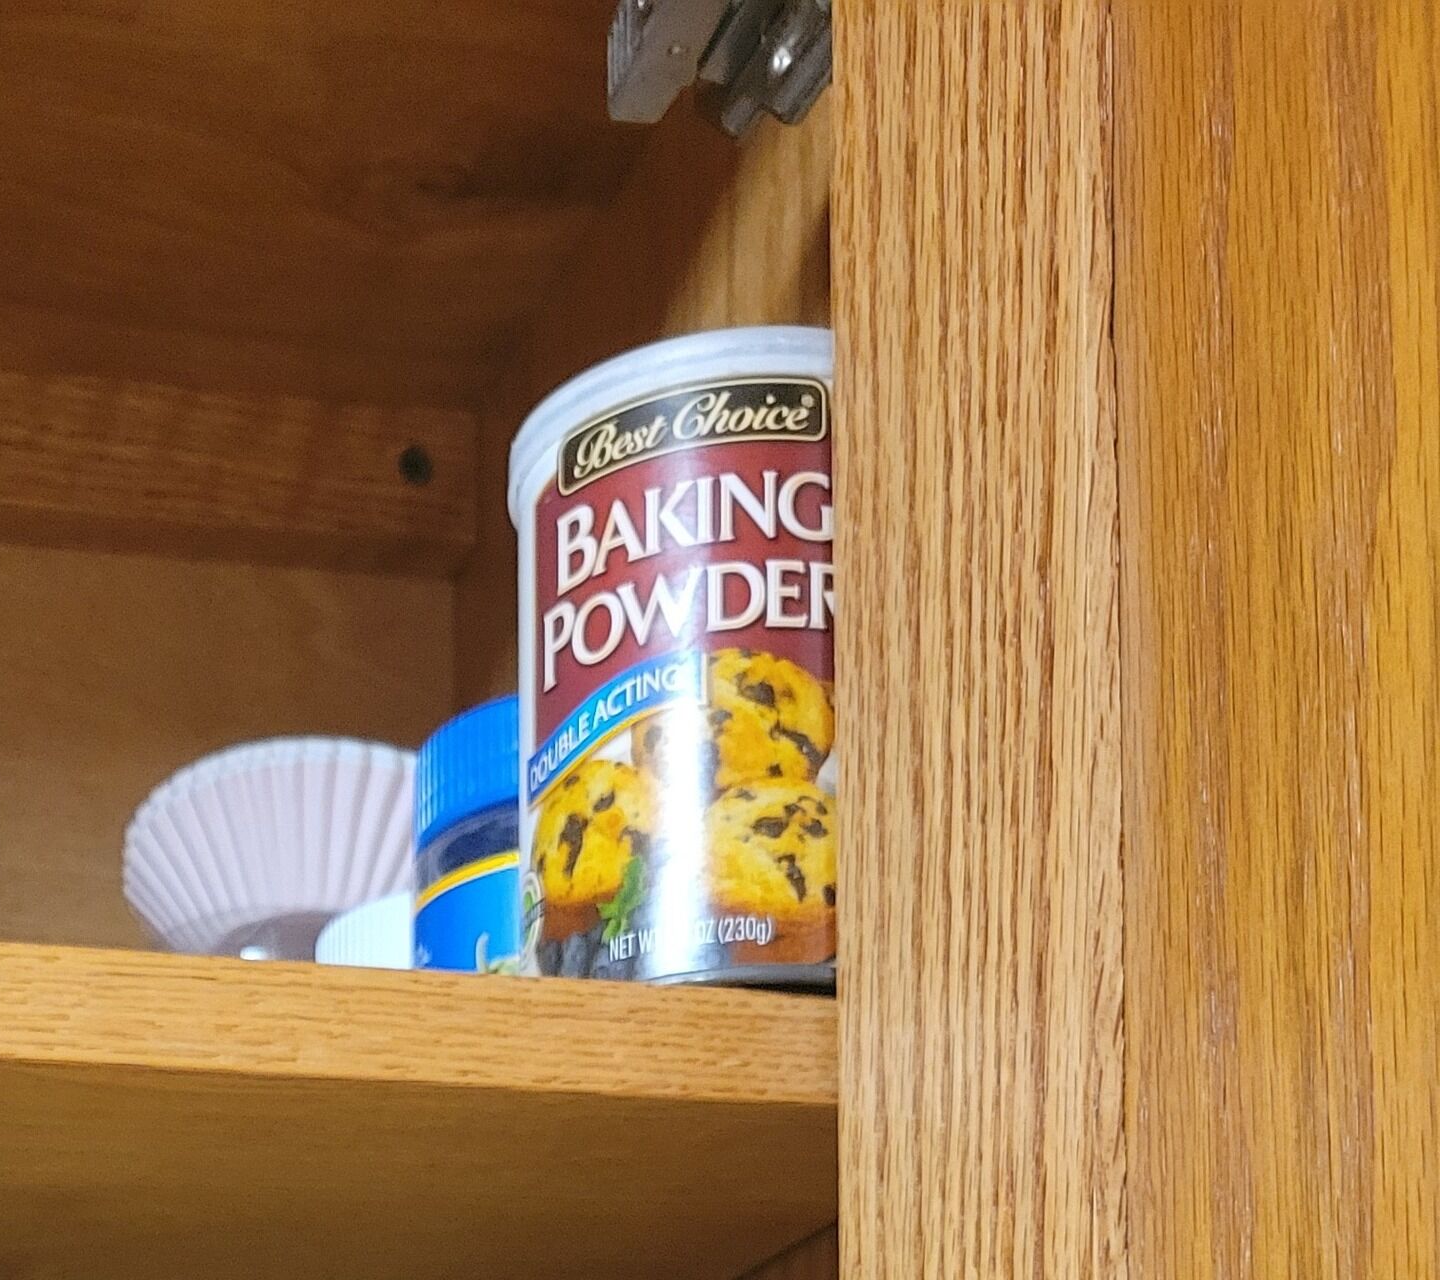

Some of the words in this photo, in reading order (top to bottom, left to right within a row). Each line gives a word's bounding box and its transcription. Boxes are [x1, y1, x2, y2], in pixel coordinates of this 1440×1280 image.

[573, 413, 667, 480] Best
[672, 392, 812, 441] Choice
[557, 470, 833, 597] BAKING
[543, 559, 834, 694] POWDER
[530, 711, 591, 793] DOUBLE
[593, 664, 682, 729] ACTING
[609, 932, 636, 962] NET
[717, 916, 773, 947] (230g)
